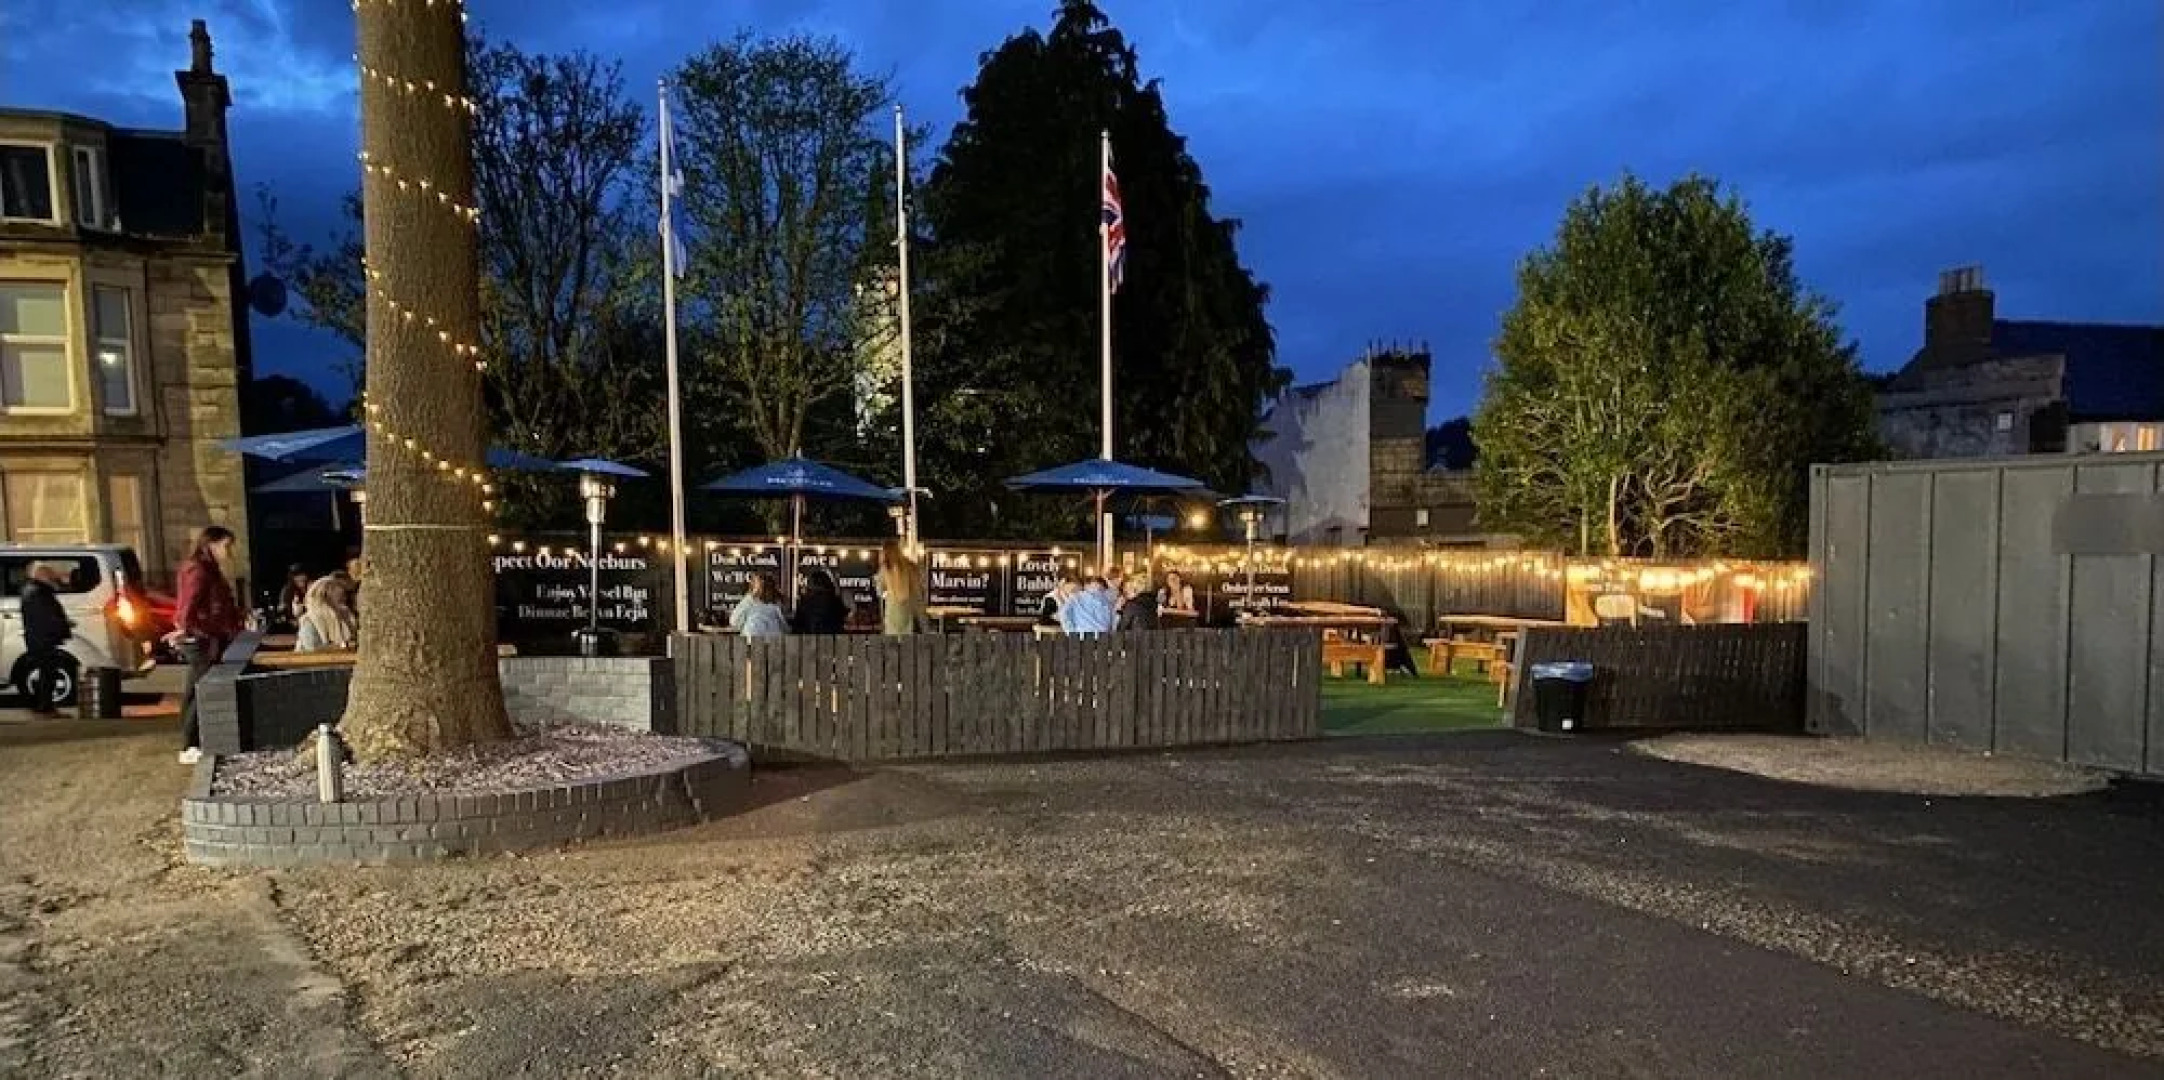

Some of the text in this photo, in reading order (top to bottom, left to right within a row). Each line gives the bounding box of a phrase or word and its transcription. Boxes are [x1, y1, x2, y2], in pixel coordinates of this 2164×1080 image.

[748, 553, 778, 566] Cook
[839, 577, 872, 591] urray
[931, 572, 989, 589] Marvin?
